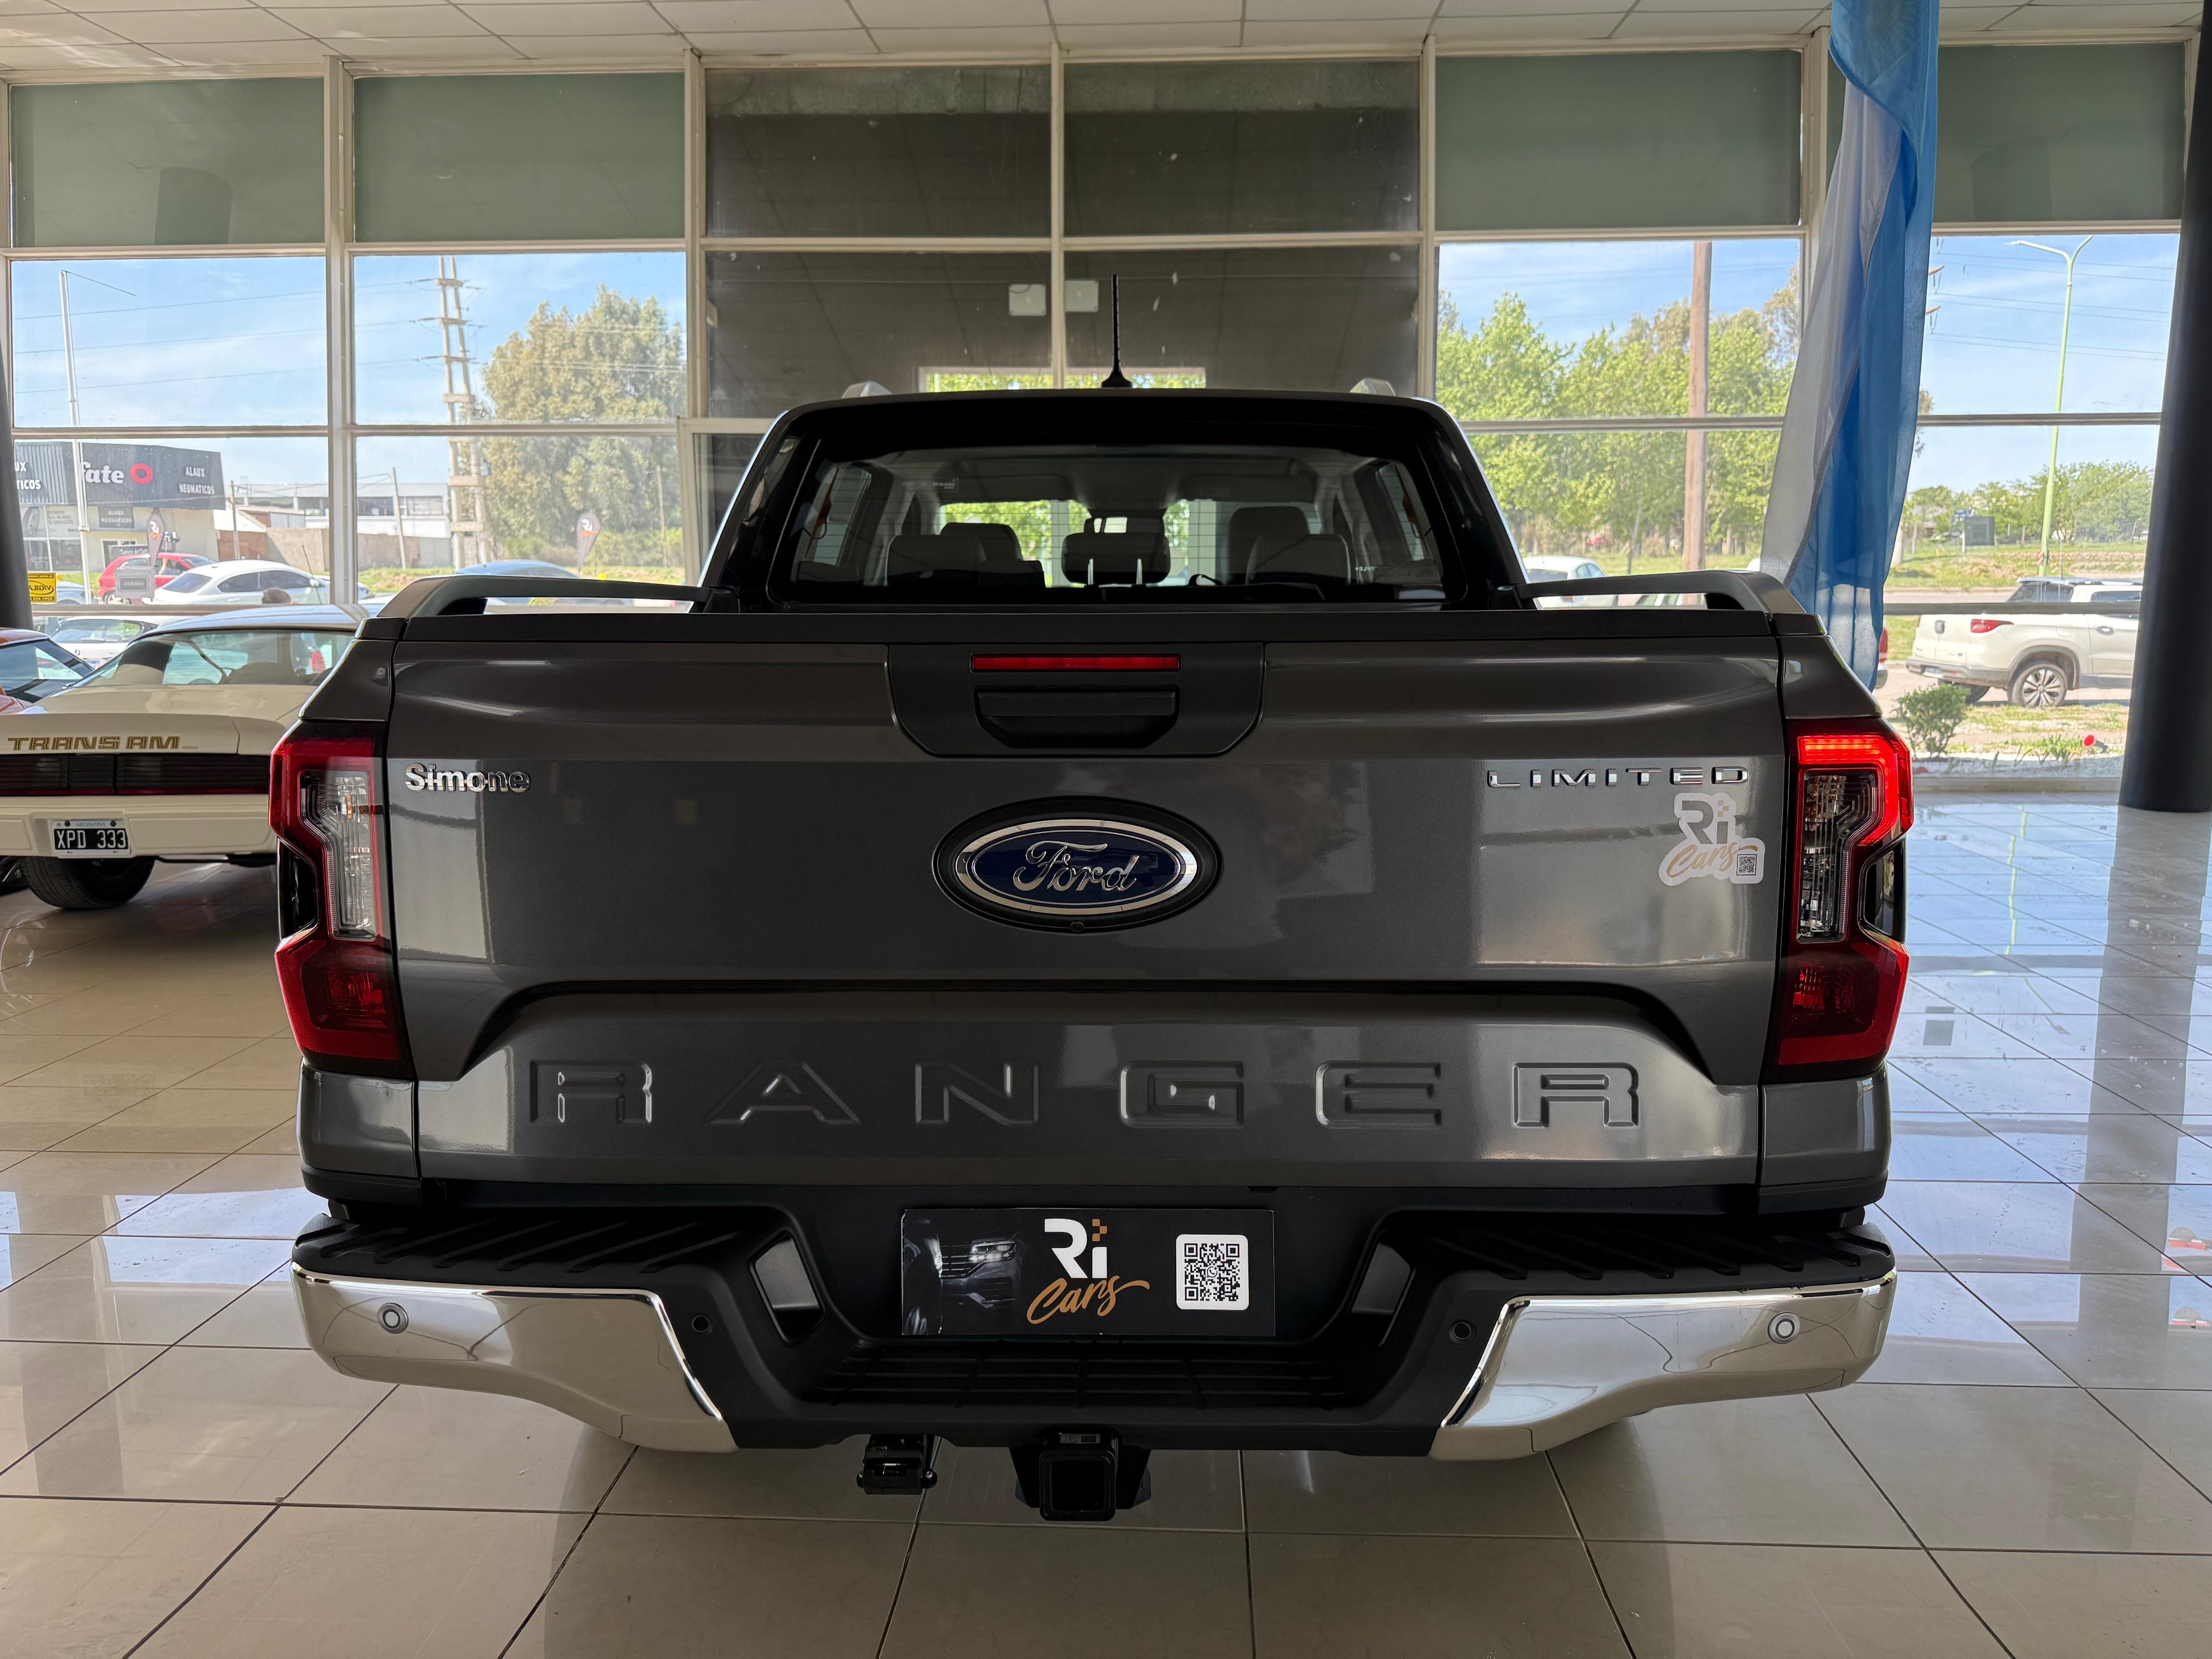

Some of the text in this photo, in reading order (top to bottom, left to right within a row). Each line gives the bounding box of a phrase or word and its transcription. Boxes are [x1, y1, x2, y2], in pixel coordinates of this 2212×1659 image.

[185, 466, 205, 477] ALAUX
[179, 483, 215, 495] NEUMATICOS
[7, 736, 180, 751] TRANS AM
[405, 763, 531, 793] Simone
[1487, 766, 1750, 787] LIMITED
[56, 830, 126, 849] XPD 333
[1013, 840, 1139, 892] Ford
[1666, 842, 1758, 878] Cars
[530, 1060, 1640, 1128] RANGER
[1026, 1275, 1150, 1325] Cars
